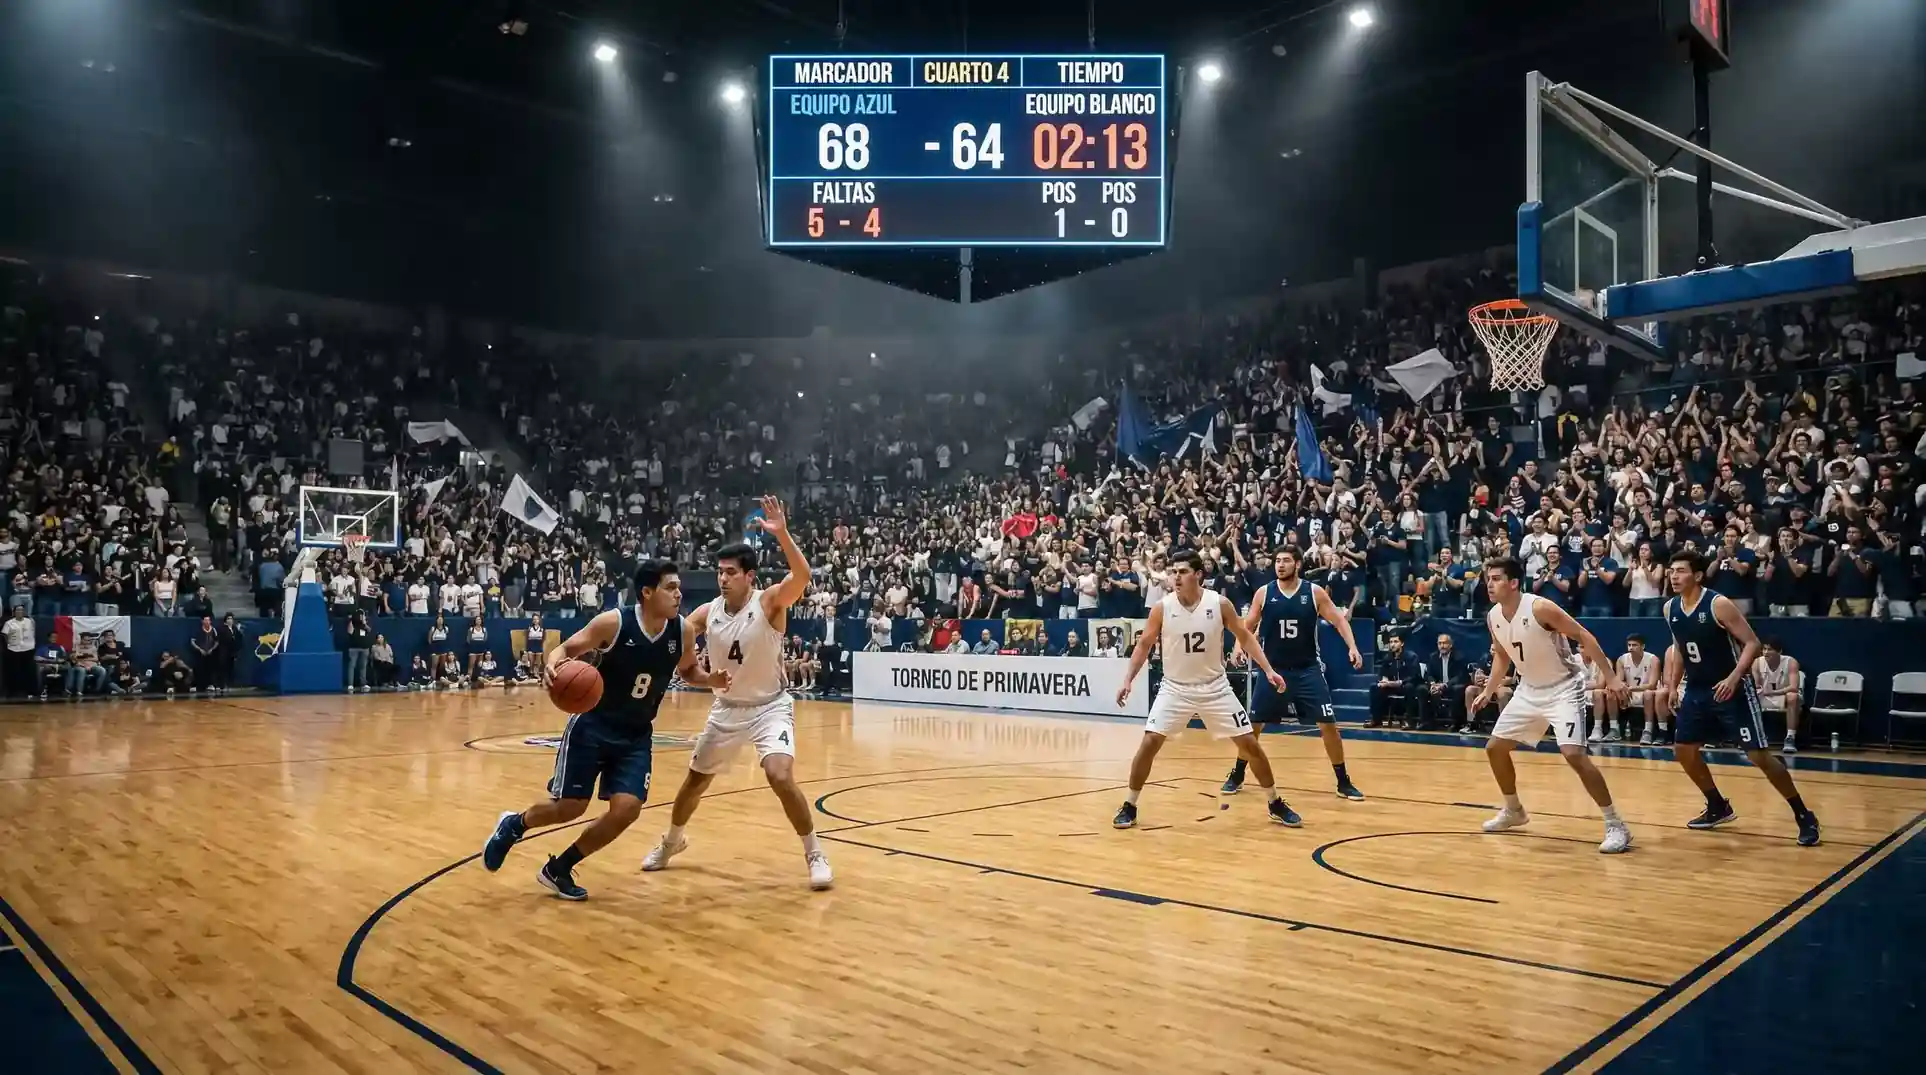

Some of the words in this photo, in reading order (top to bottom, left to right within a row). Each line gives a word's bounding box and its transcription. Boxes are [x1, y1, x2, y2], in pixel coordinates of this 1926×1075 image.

[795, 62, 893, 84] MARCADOR
[924, 62, 993, 84] CUARTO
[996, 62, 1010, 84] 4
[1057, 62, 1124, 84] TIEMPO
[791, 94, 851, 116] EQUIPO
[854, 94, 897, 115] AZUL
[1026, 93, 1086, 116] EQUIPO
[1089, 93, 1156, 115] BLANCO
[818, 122, 870, 170] 68
[952, 122, 1005, 169] 64
[1033, 122, 1148, 170] 02:13
[813, 182, 876, 204] FALTAS
[1042, 182, 1076, 204] POS
[1102, 182, 1137, 204] POS
[808, 207, 824, 238] 5
[863, 207, 881, 238] 4
[1054, 207, 1065, 238] 1
[1111, 207, 1128, 238] 0
[1279, 619, 1298, 639] 15
[728, 639, 743, 665] 4
[1183, 631, 1206, 654] 12
[1511, 641, 1525, 662] 7
[1686, 642, 1702, 663] 9
[631, 673, 652, 699] 8
[891, 667, 952, 690] TORNEO
[957, 670, 978, 691] DE
[983, 671, 1091, 697] PRIMAVERA
[1231, 710, 1250, 728] 12
[1321, 703, 1333, 717] 15
[778, 730, 790, 746] 4
[1565, 722, 1576, 738] 7
[1739, 727, 1751, 742] 9
